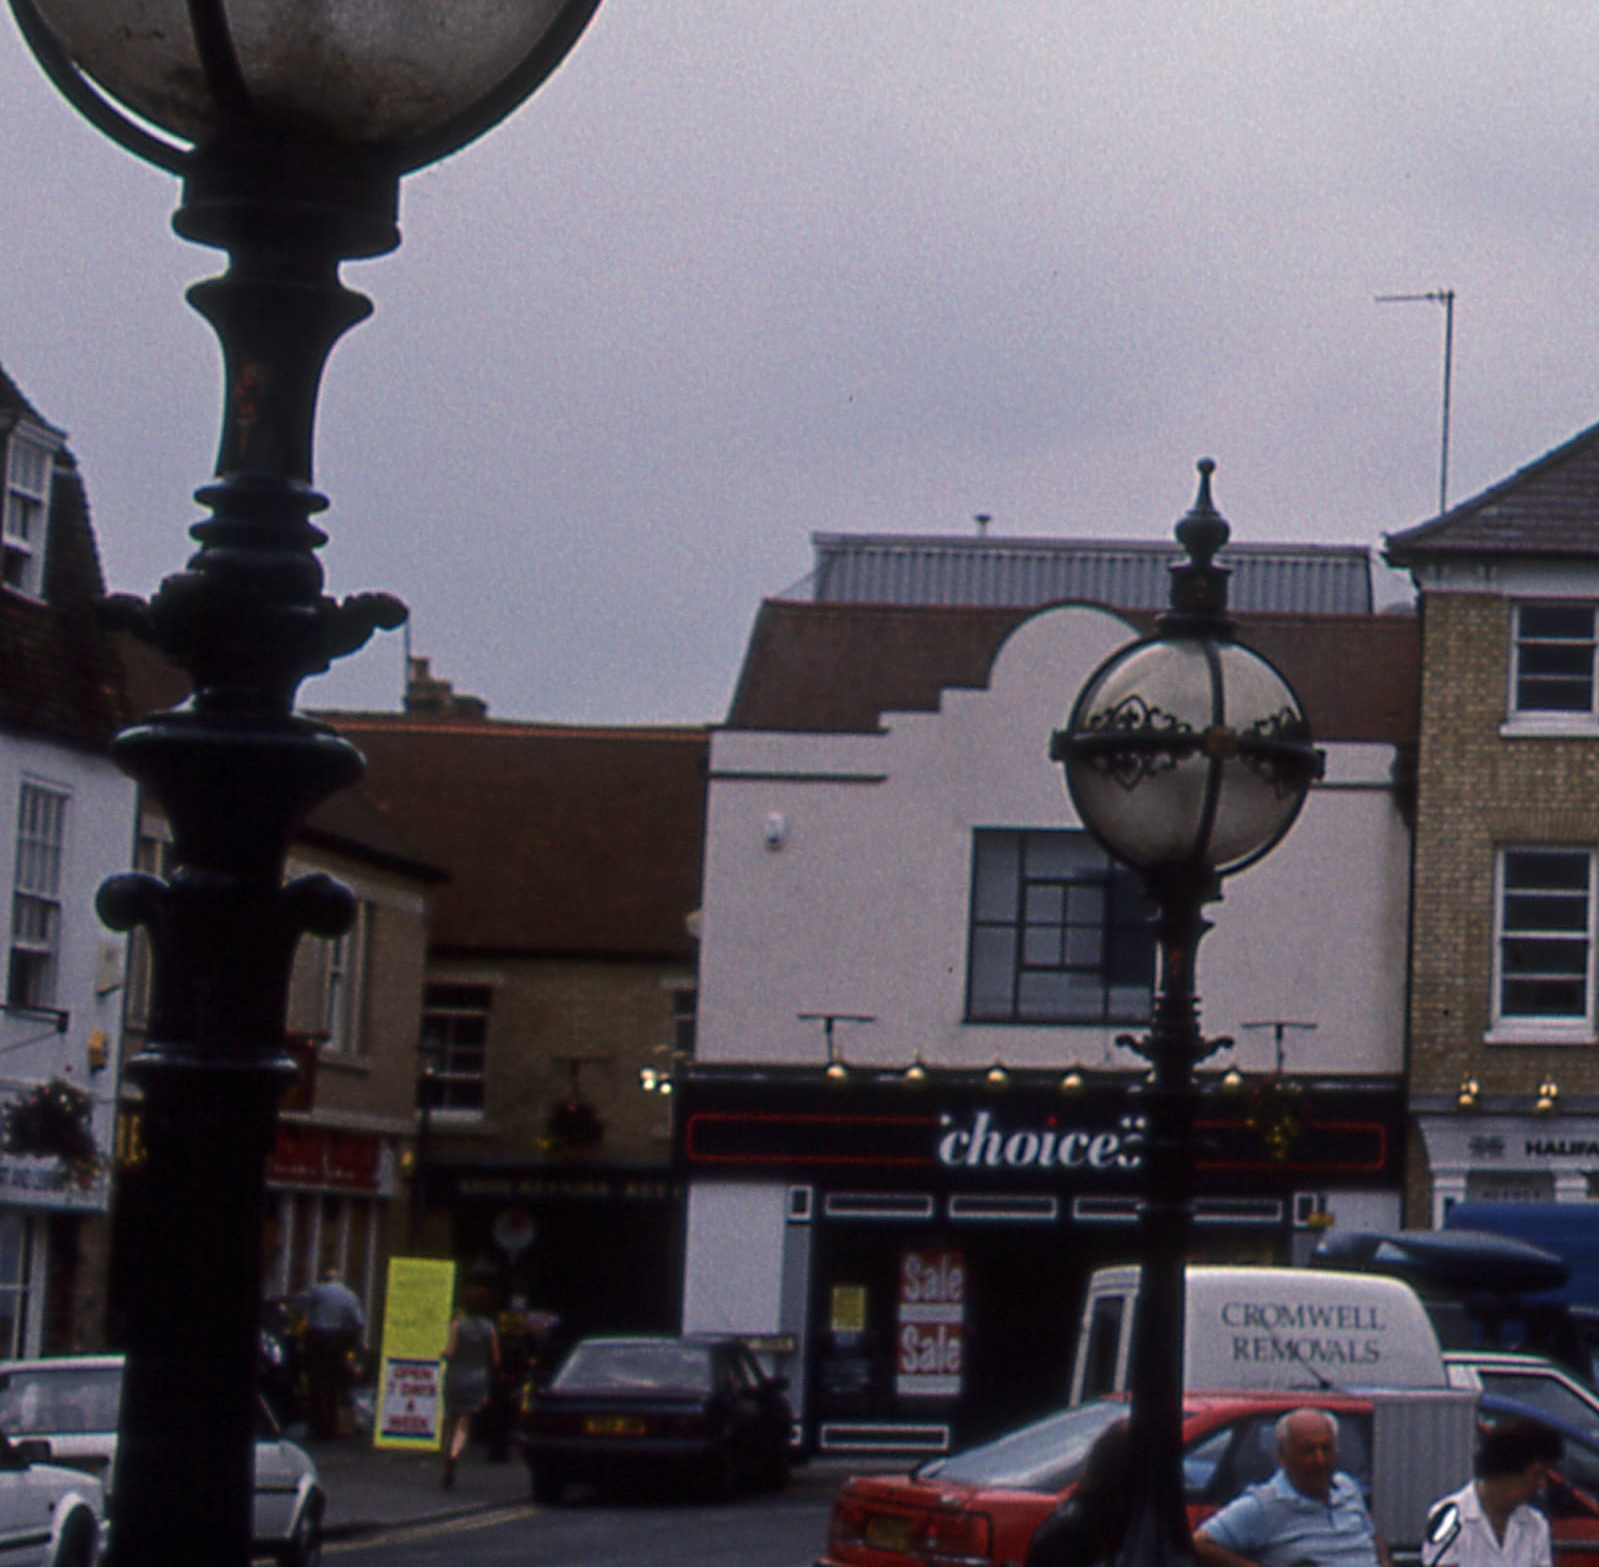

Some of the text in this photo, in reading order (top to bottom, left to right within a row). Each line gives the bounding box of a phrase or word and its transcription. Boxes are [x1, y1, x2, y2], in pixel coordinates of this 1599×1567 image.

[902, 1252, 963, 1303] Sale
[1220, 1300, 1387, 1332] CROMWELL
[901, 1324, 961, 1374] Sale
[1232, 1335, 1382, 1365] REMOVALS
